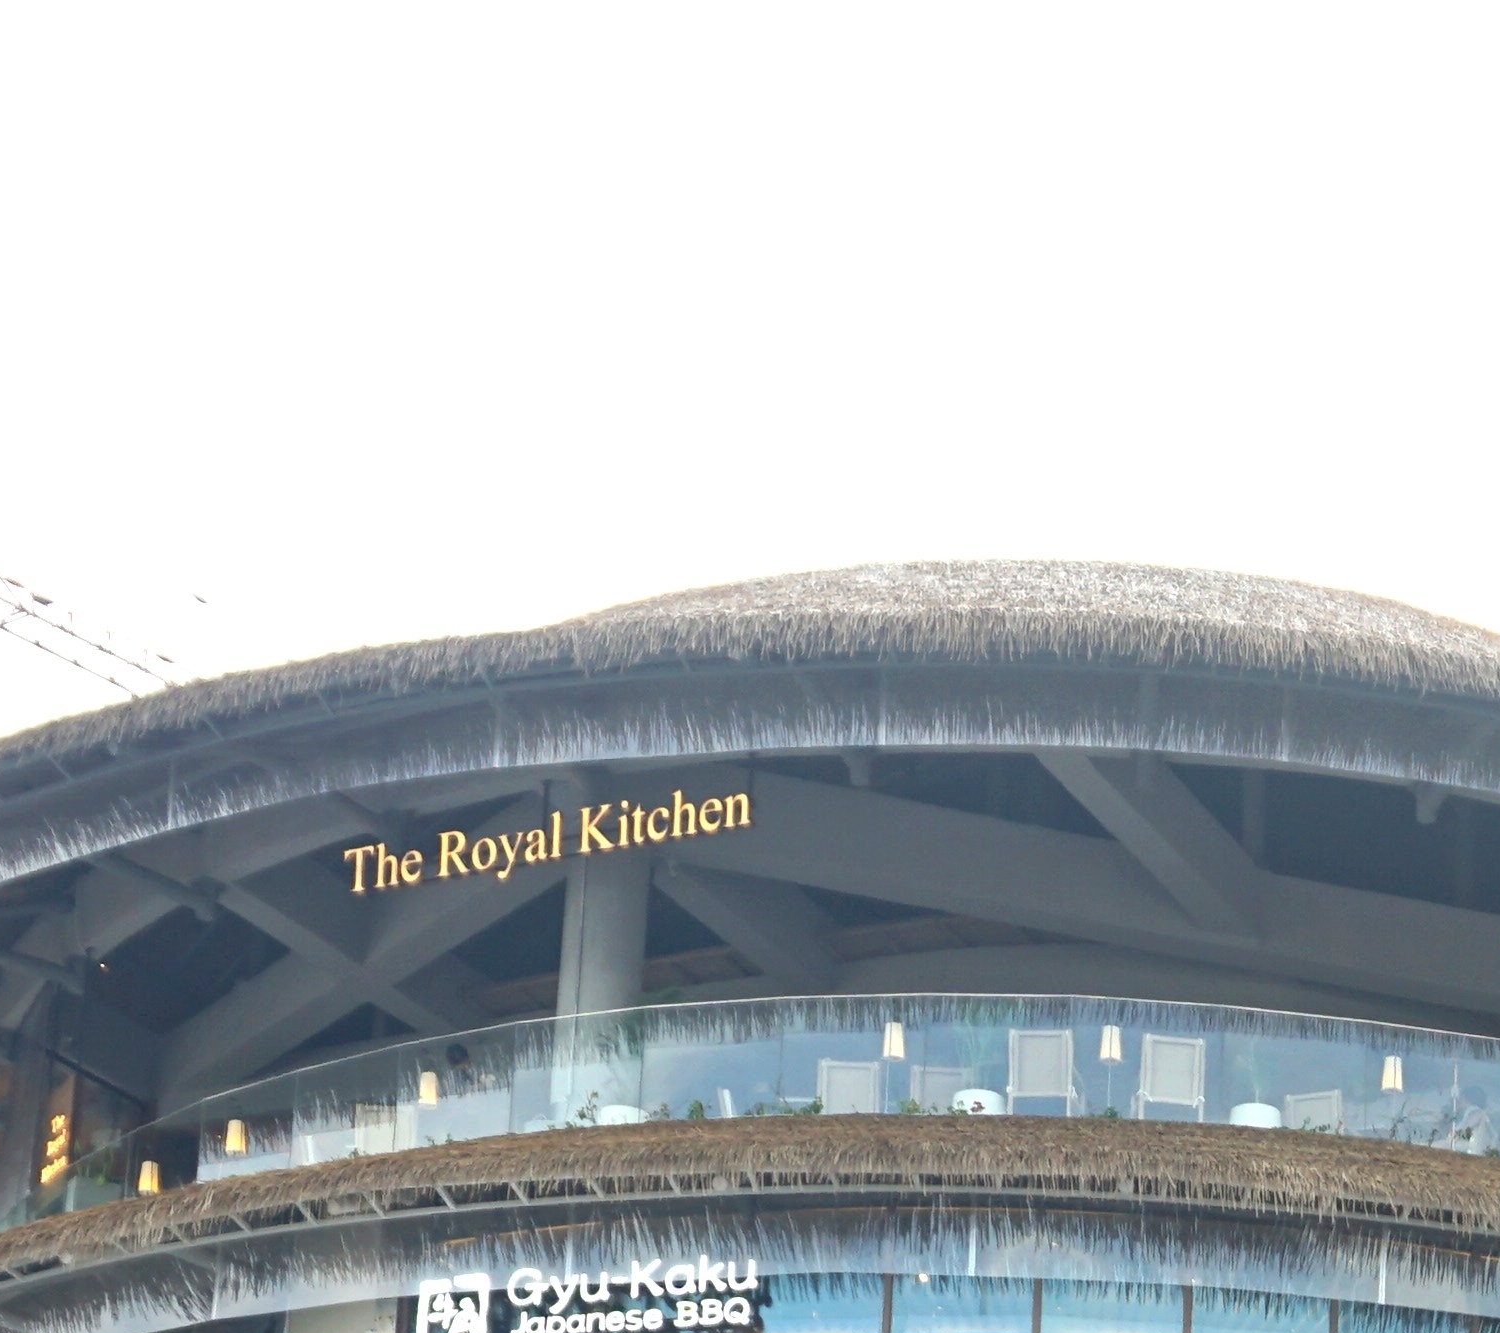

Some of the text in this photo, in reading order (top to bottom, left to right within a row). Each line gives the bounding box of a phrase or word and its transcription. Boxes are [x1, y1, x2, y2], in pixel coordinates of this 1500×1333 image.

[342, 789, 752, 893] The Royal Kitchen
[506, 1254, 759, 1315] Gyu-Kaku
[673, 1296, 751, 1329] BBQ
